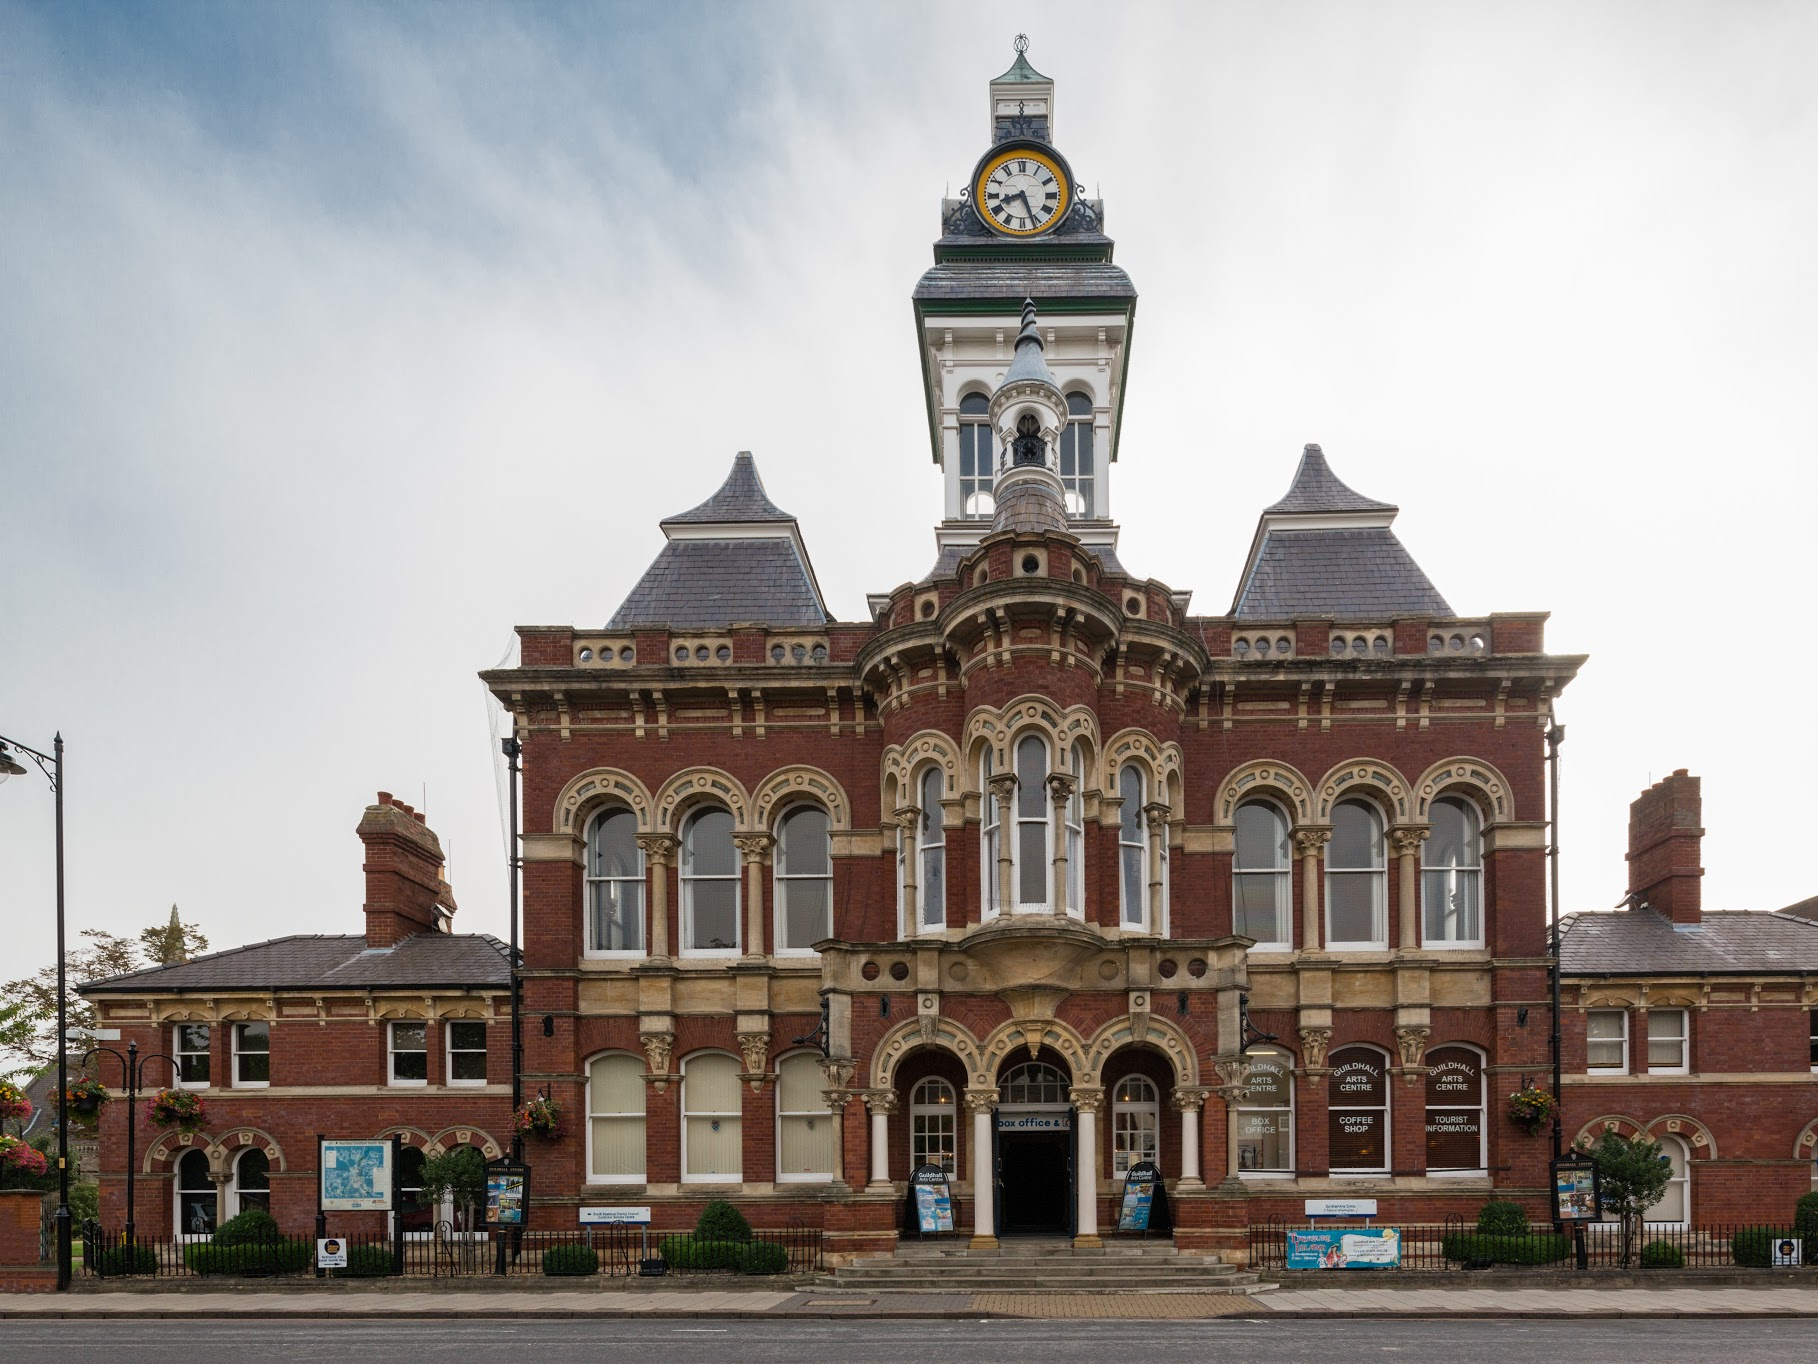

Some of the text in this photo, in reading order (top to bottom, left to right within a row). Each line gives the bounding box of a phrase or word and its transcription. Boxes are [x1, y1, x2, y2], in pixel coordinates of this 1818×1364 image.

[1250, 1064, 1283, 1077] ILDHALL
[1334, 1063, 1378, 1077] GUILDHALL
[1430, 1062, 1474, 1076] GUILDHALL
[998, 1118, 1015, 1127] box
[1019, 1118, 1050, 1126] office
